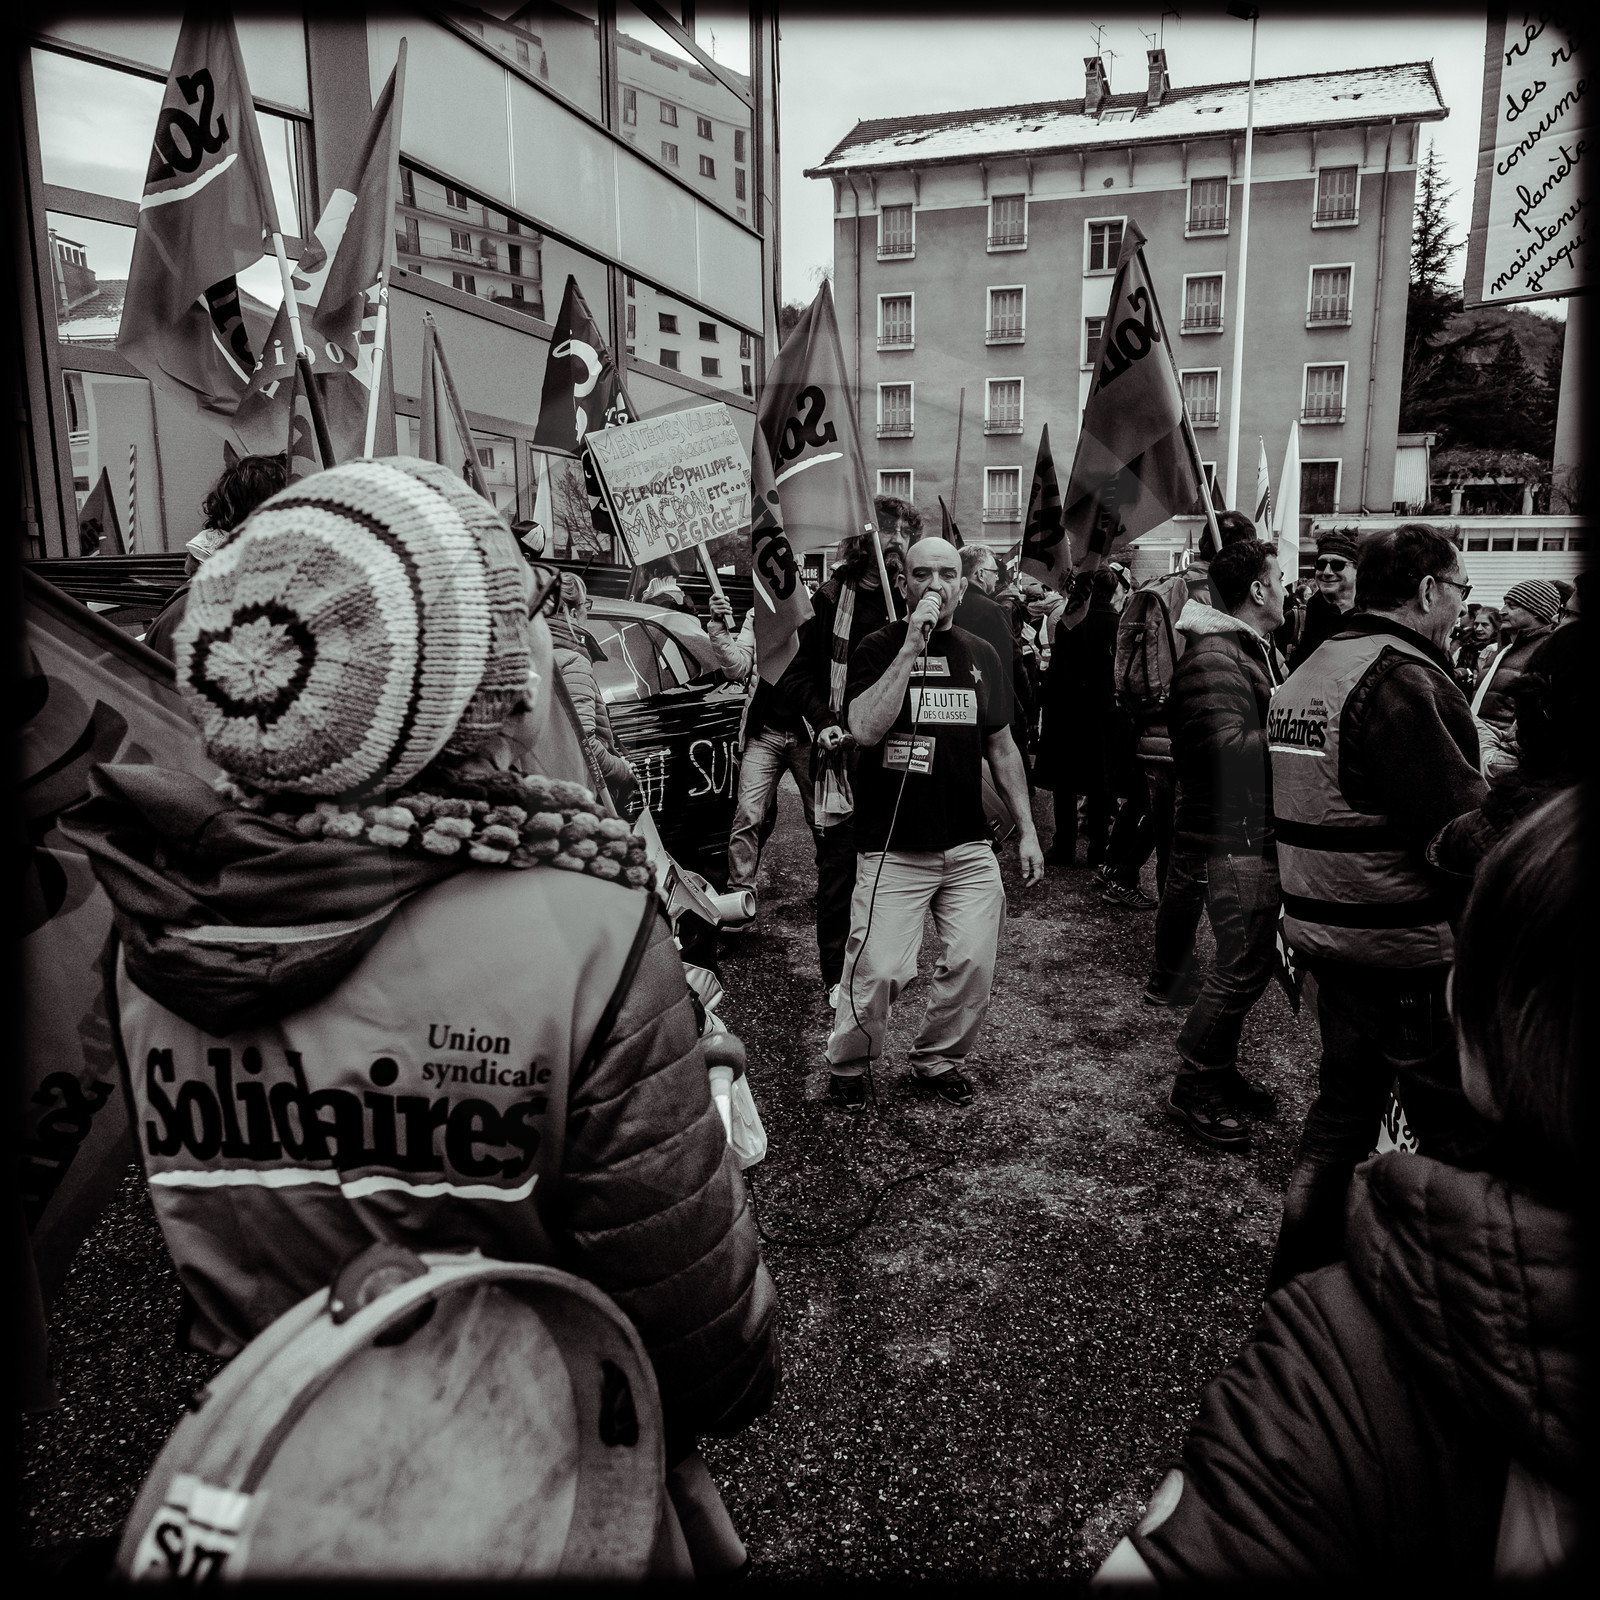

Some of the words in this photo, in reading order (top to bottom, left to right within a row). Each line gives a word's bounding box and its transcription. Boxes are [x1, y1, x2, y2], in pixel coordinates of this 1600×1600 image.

[1506, 80, 1547, 122] des
[1497, 72, 1595, 176] consume
[1513, 139, 1594, 233] planète
[1525, 219, 1592, 292] jusqu'
[684, 455, 742, 488] PHILIPPE,
[923, 710, 937, 720] DES
[938, 710, 967, 720] CLASSES
[934, 693, 970, 708] LUTTE
[1268, 708, 1329, 748] Slidaires
[427, 1023, 512, 1056] Union
[422, 1056, 552, 1089] syndicale
[146, 1045, 550, 1179] Solidaires
